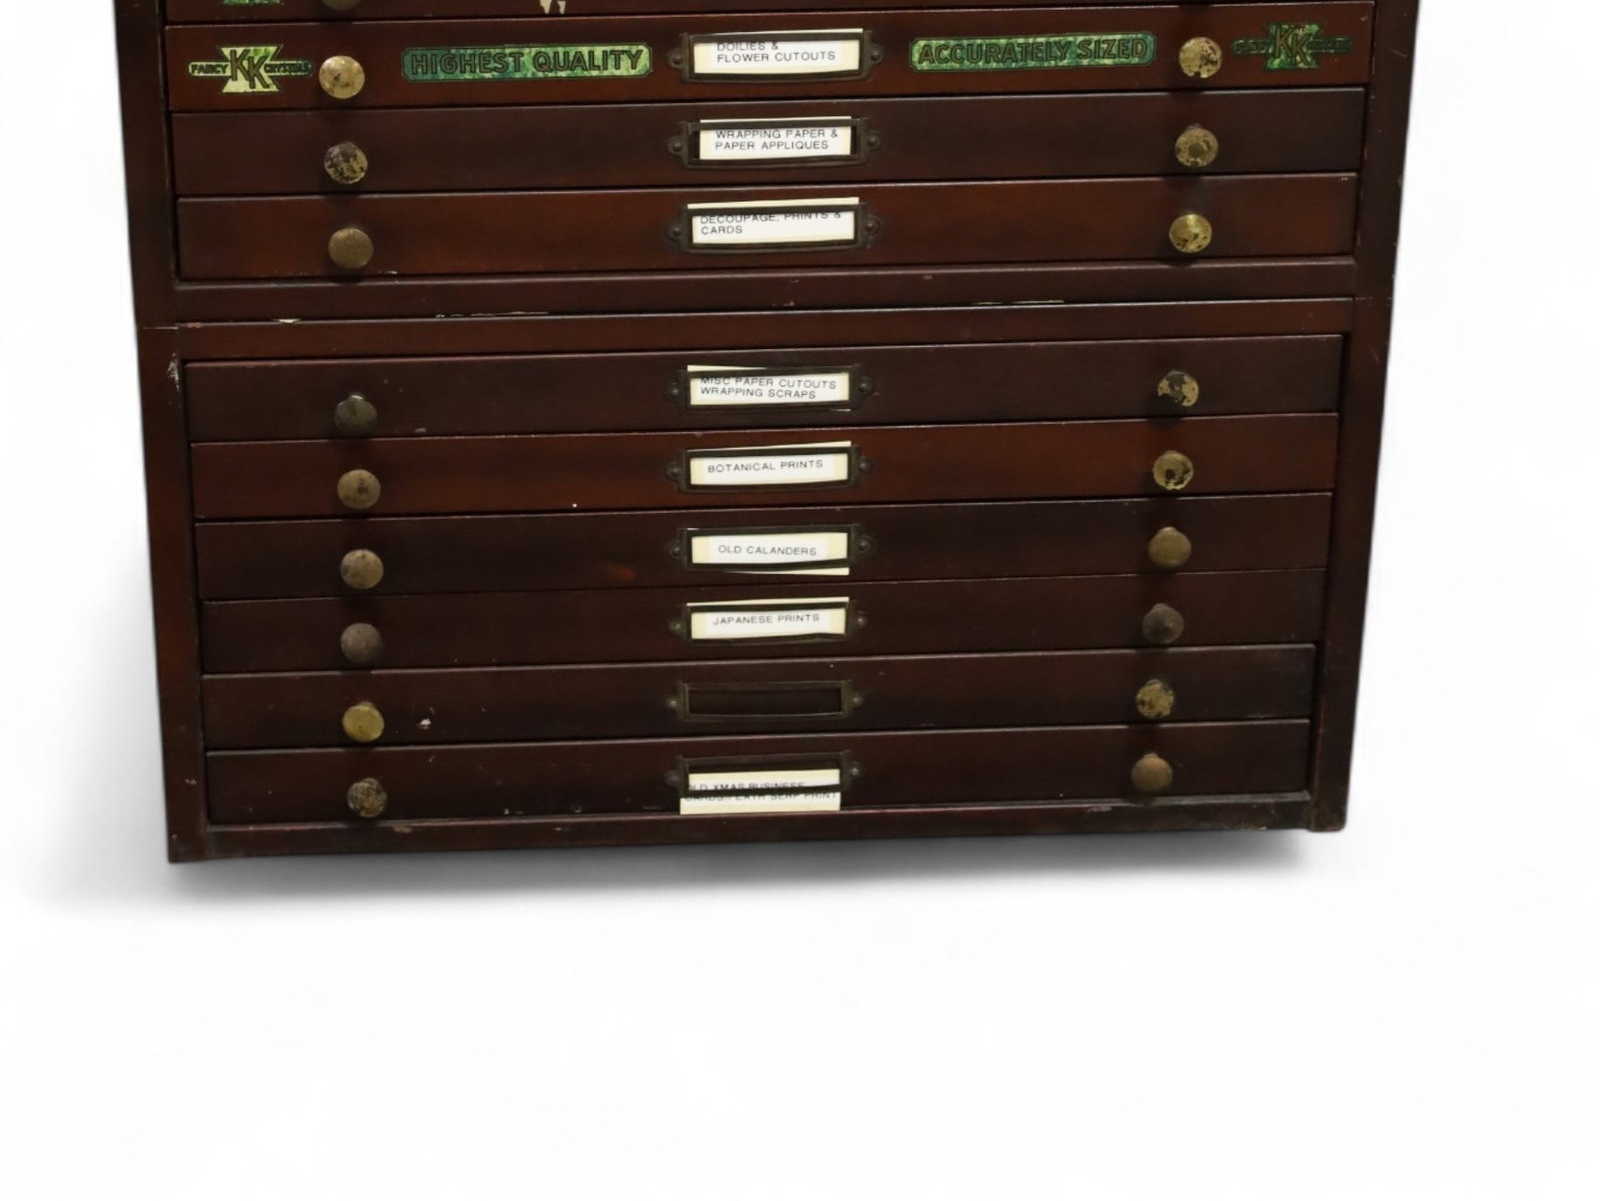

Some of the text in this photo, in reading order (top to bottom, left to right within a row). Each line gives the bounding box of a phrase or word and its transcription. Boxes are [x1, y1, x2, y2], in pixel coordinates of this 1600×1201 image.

[717, 42, 765, 51] DOILIES
[917, 38, 1149, 65] ACCURATELY SIZED
[717, 51, 836, 63] FLOWER CUTOUTS
[411, 50, 643, 76] HIGHEST QUALITY
[716, 129, 837, 138] WRAPPING PAPER &
[716, 140, 828, 150] PAPER APPLIQUES
[701, 226, 743, 235] CARDS
[735, 377, 773, 386] PAPER
[779, 379, 837, 389] CUTOUTS
[701, 387, 816, 399] WRAPPING SCRAPS
[708, 460, 823, 473] BOTANICAL PRINTS
[718, 545, 816, 556] OLD CALANDERS
[713, 614, 819, 625] JAPANESE PRINTS
